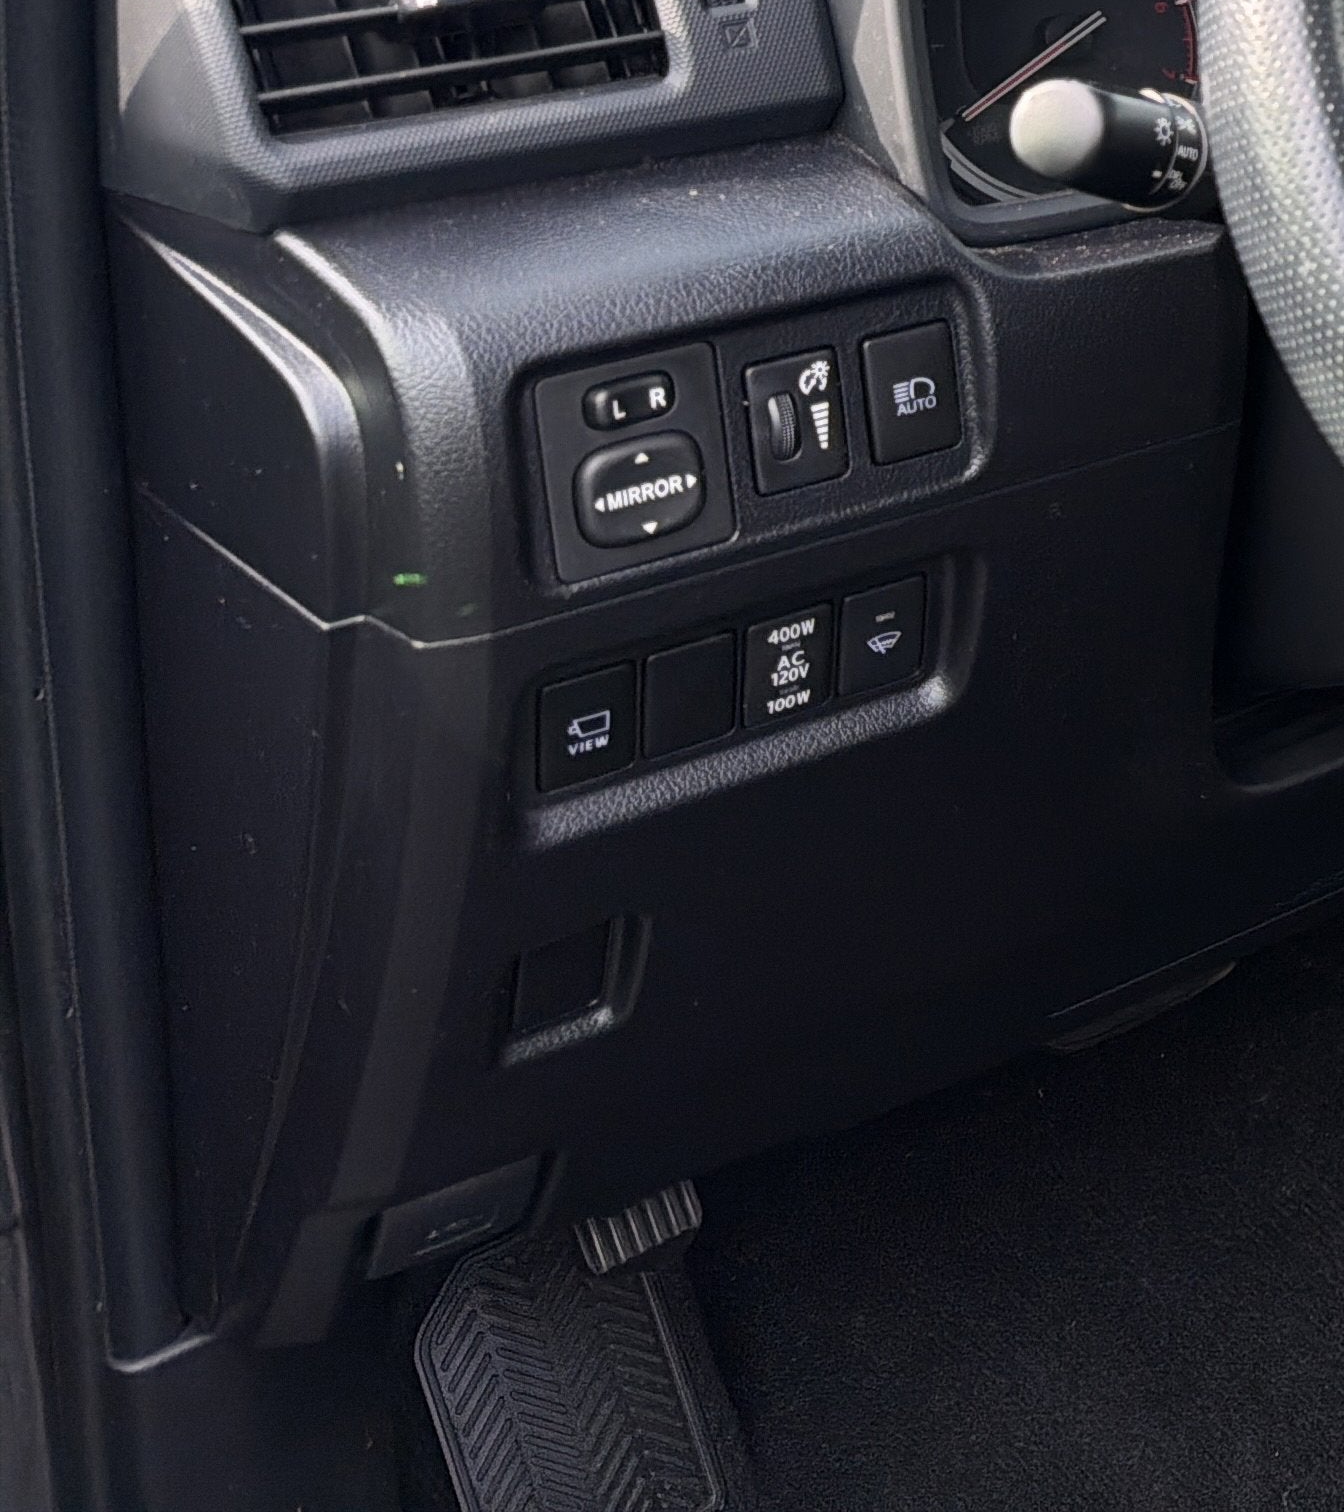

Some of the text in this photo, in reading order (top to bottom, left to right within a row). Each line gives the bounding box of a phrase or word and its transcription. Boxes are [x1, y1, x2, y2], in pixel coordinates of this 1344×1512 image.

[1154, 0, 1168, 14] 6
[1177, 144, 1199, 161] AUTO
[612, 386, 667, 420] L R
[897, 395, 937, 417] AUTO
[606, 474, 684, 512] MIRROR
[767, 617, 815, 645] 400W
[777, 649, 806, 672] AC
[770, 662, 810, 687] 120V
[766, 688, 811, 715] 100W
[567, 734, 610, 757] VIEW
